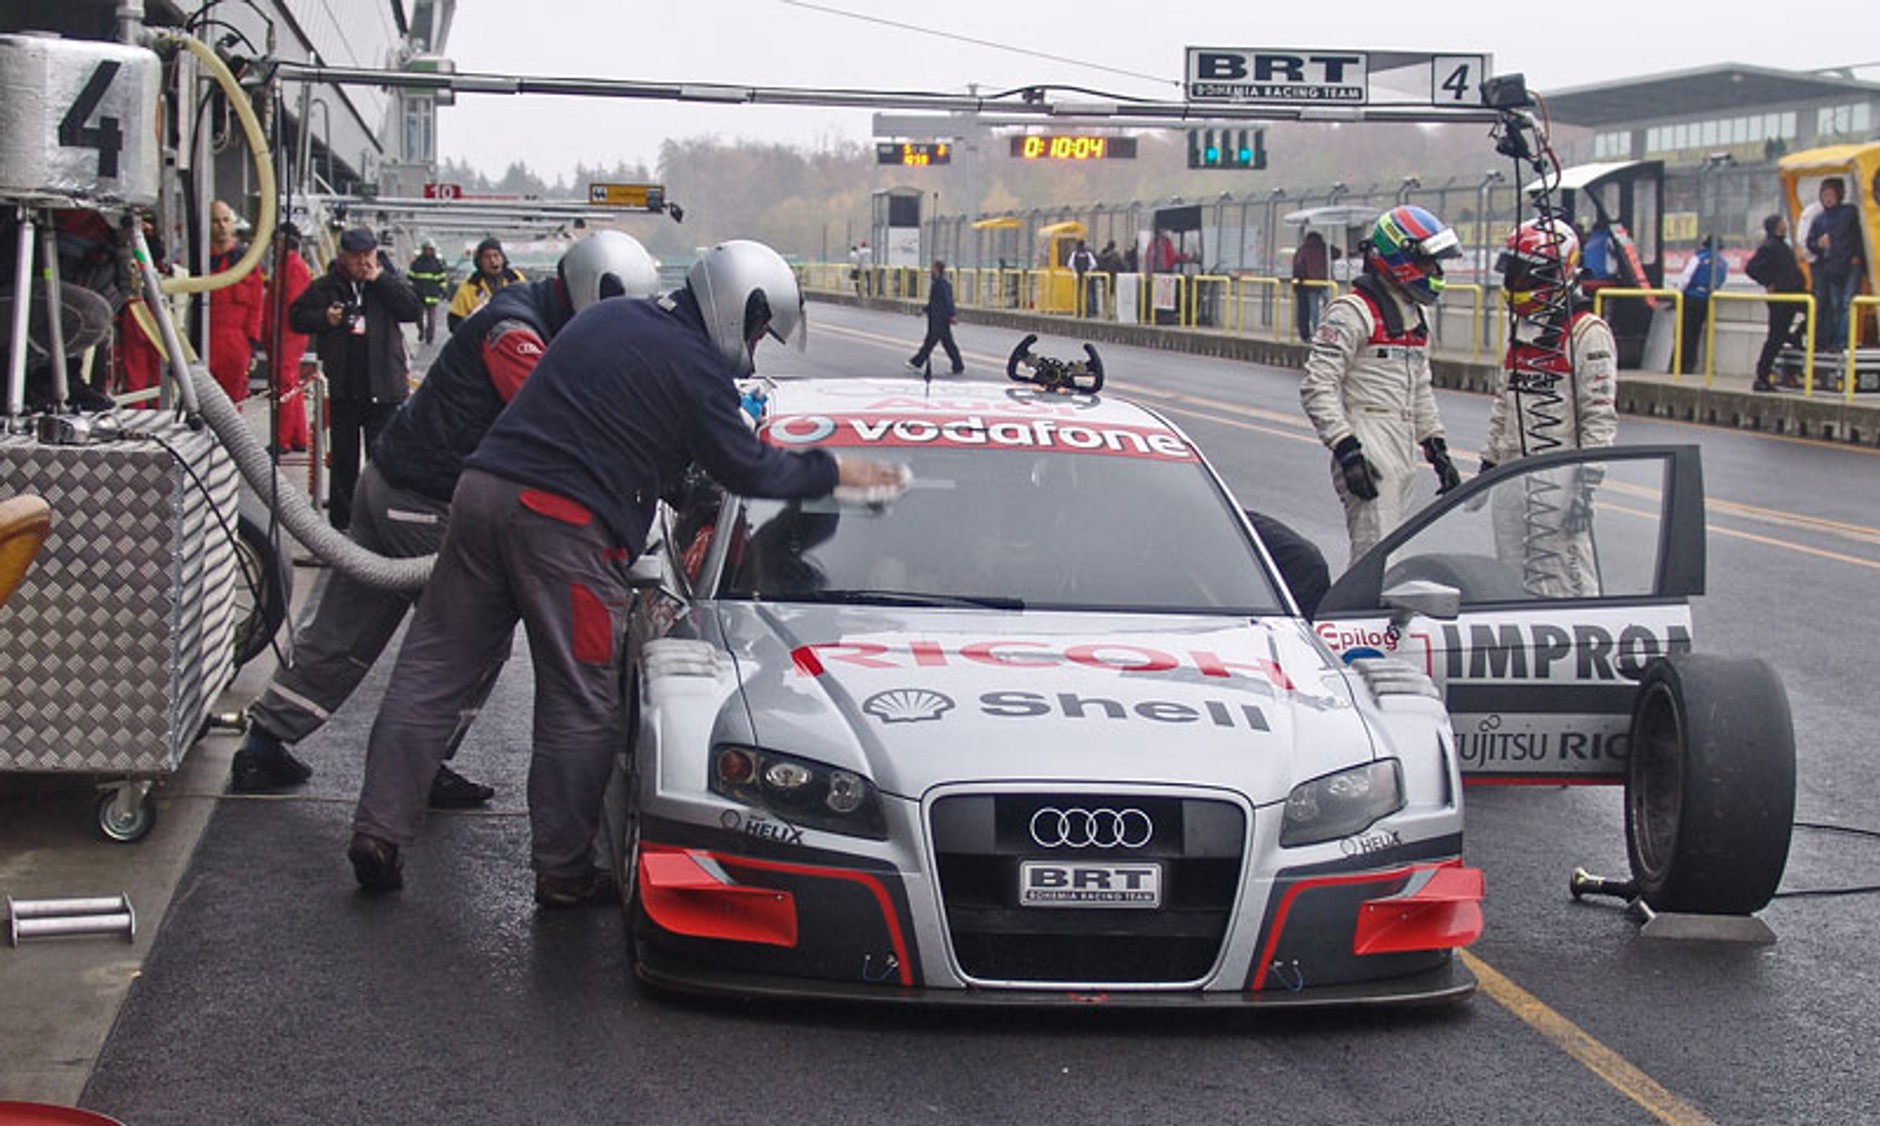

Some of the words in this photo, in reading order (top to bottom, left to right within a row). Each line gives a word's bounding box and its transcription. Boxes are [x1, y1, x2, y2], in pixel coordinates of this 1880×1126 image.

[1198, 53, 1359, 83] BRT
[1441, 63, 1470, 100] 4
[1196, 84, 1259, 97] BOHEMIA
[1263, 86, 1319, 98] RACING
[1324, 86, 1360, 98] TEAM
[57, 59, 123, 178] 4
[429, 183, 454, 199] 10
[848, 415, 1190, 458] vodafone
[791, 641, 1296, 690] RICOH
[978, 690, 1271, 733] Shell
[744, 818, 805, 844] HELIX
[1030, 867, 1152, 889] BRT
